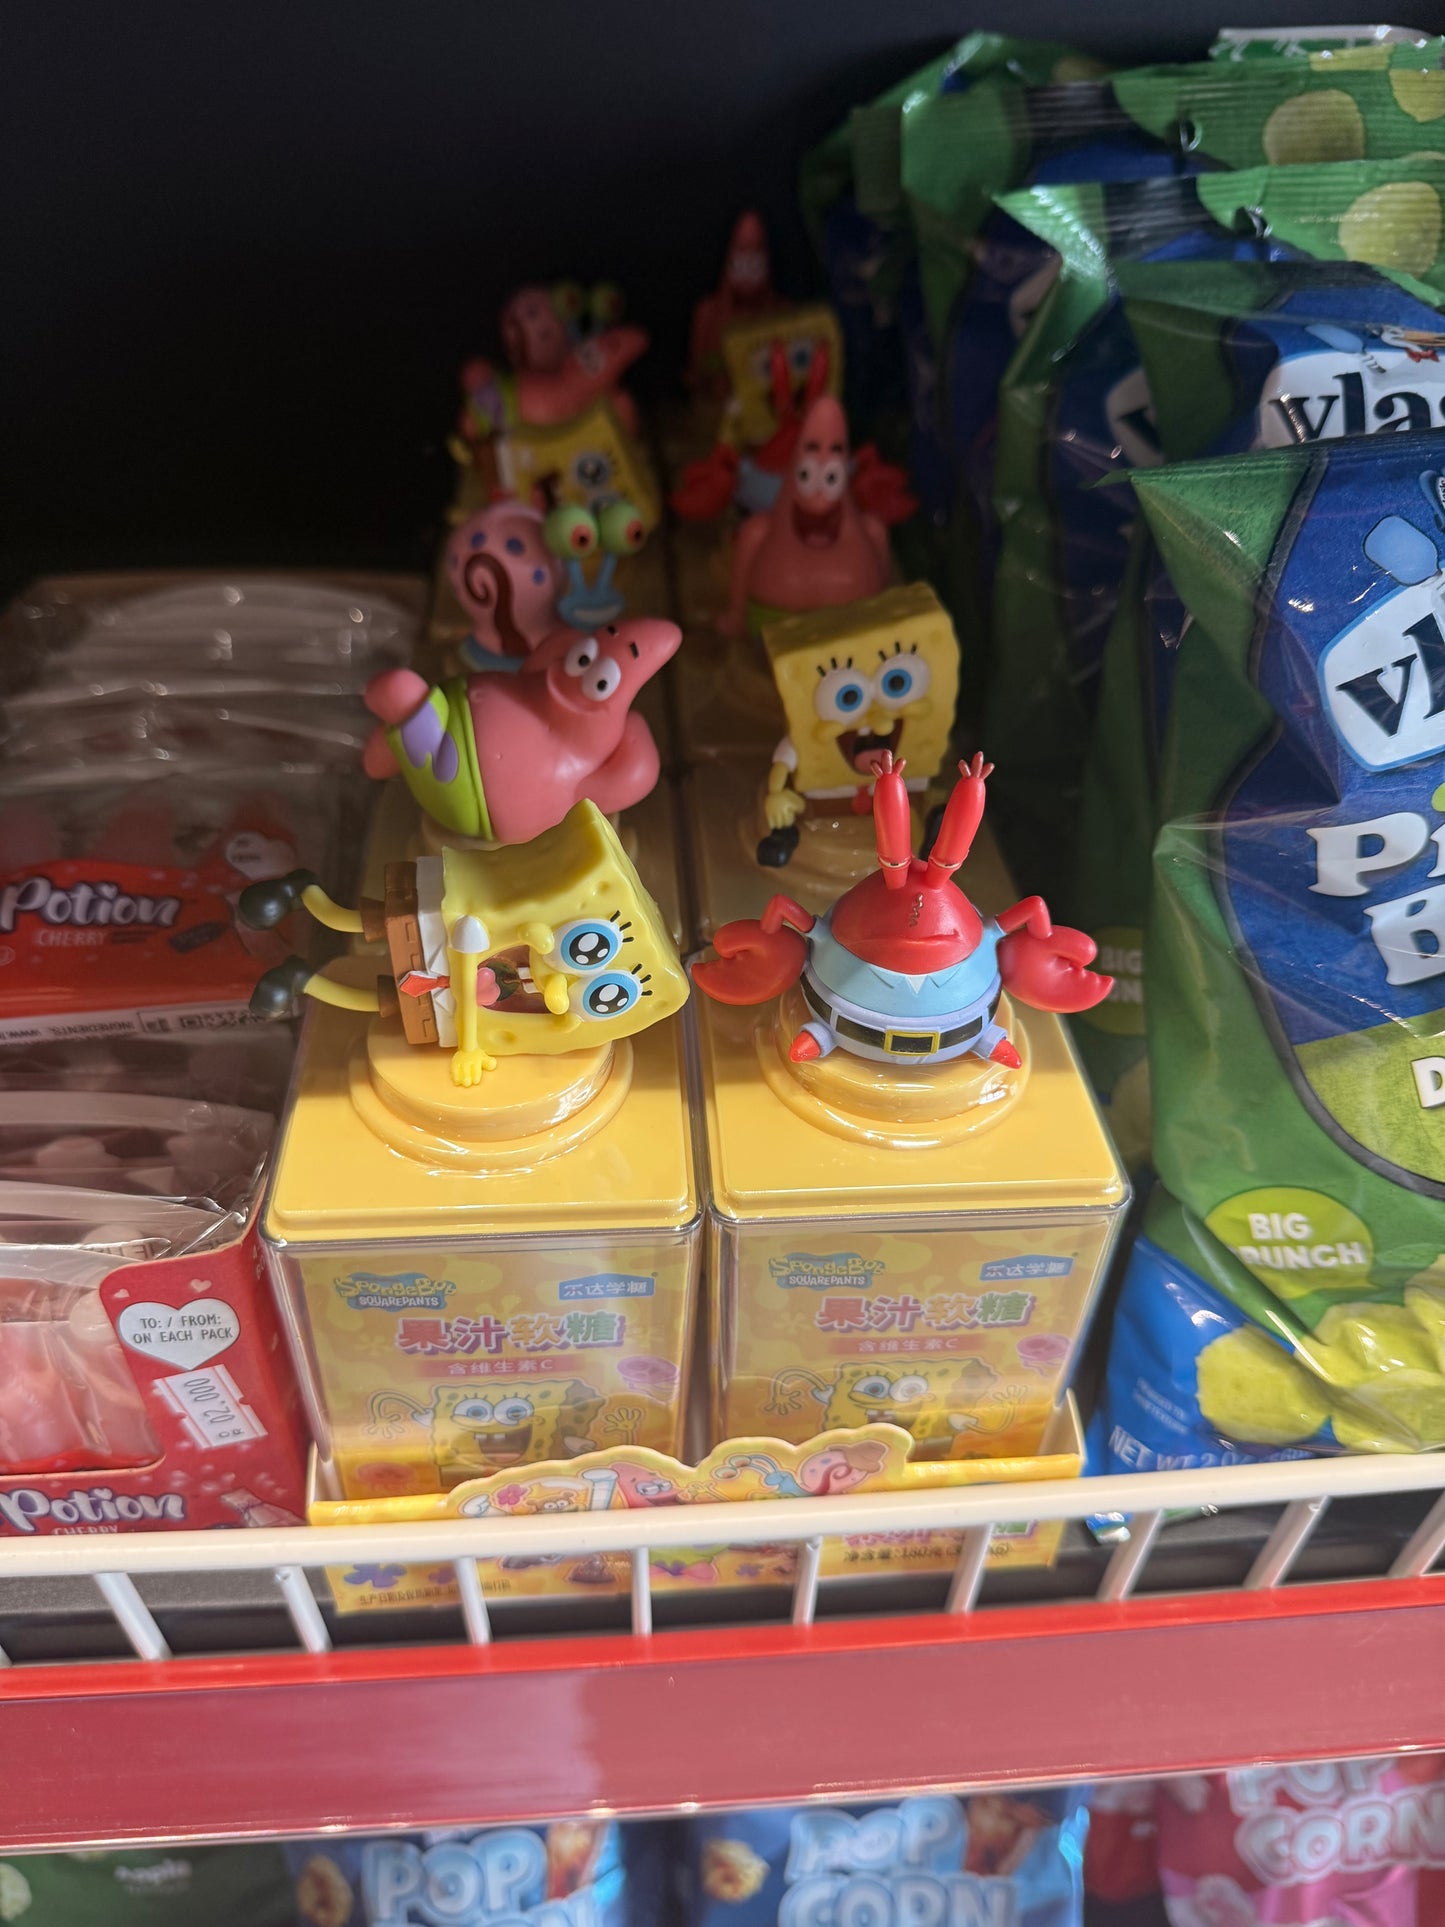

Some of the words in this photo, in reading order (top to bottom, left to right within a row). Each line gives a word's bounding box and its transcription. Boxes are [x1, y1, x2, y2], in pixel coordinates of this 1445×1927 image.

[1269, 371, 1445, 443] vla
[0, 877, 180, 932] Potion
[36, 930, 107, 947] CHERRY
[1248, 1212, 1313, 1241] BIG
[1229, 1241, 1367, 1270] RUNCH
[358, 1295, 440, 1307] SQUAREPANTS
[788, 1274, 866, 1287] SQUAREPANTS
[139, 1317, 161, 1329] TO:
[181, 1313, 222, 1327] FROM:
[814, 1290, 1034, 1331] 果汁软糖
[133, 1331, 152, 1344] ON
[160, 1329, 194, 1343] EACH
[200, 1326, 234, 1340] PACK
[395, 1310, 623, 1353] 果汁软糖
[1108, 1424, 1155, 1471] NET
[0, 1488, 186, 1533] Potion
[1234, 1787, 1445, 1888] CORN
[362, 1828, 547, 1920] POP
